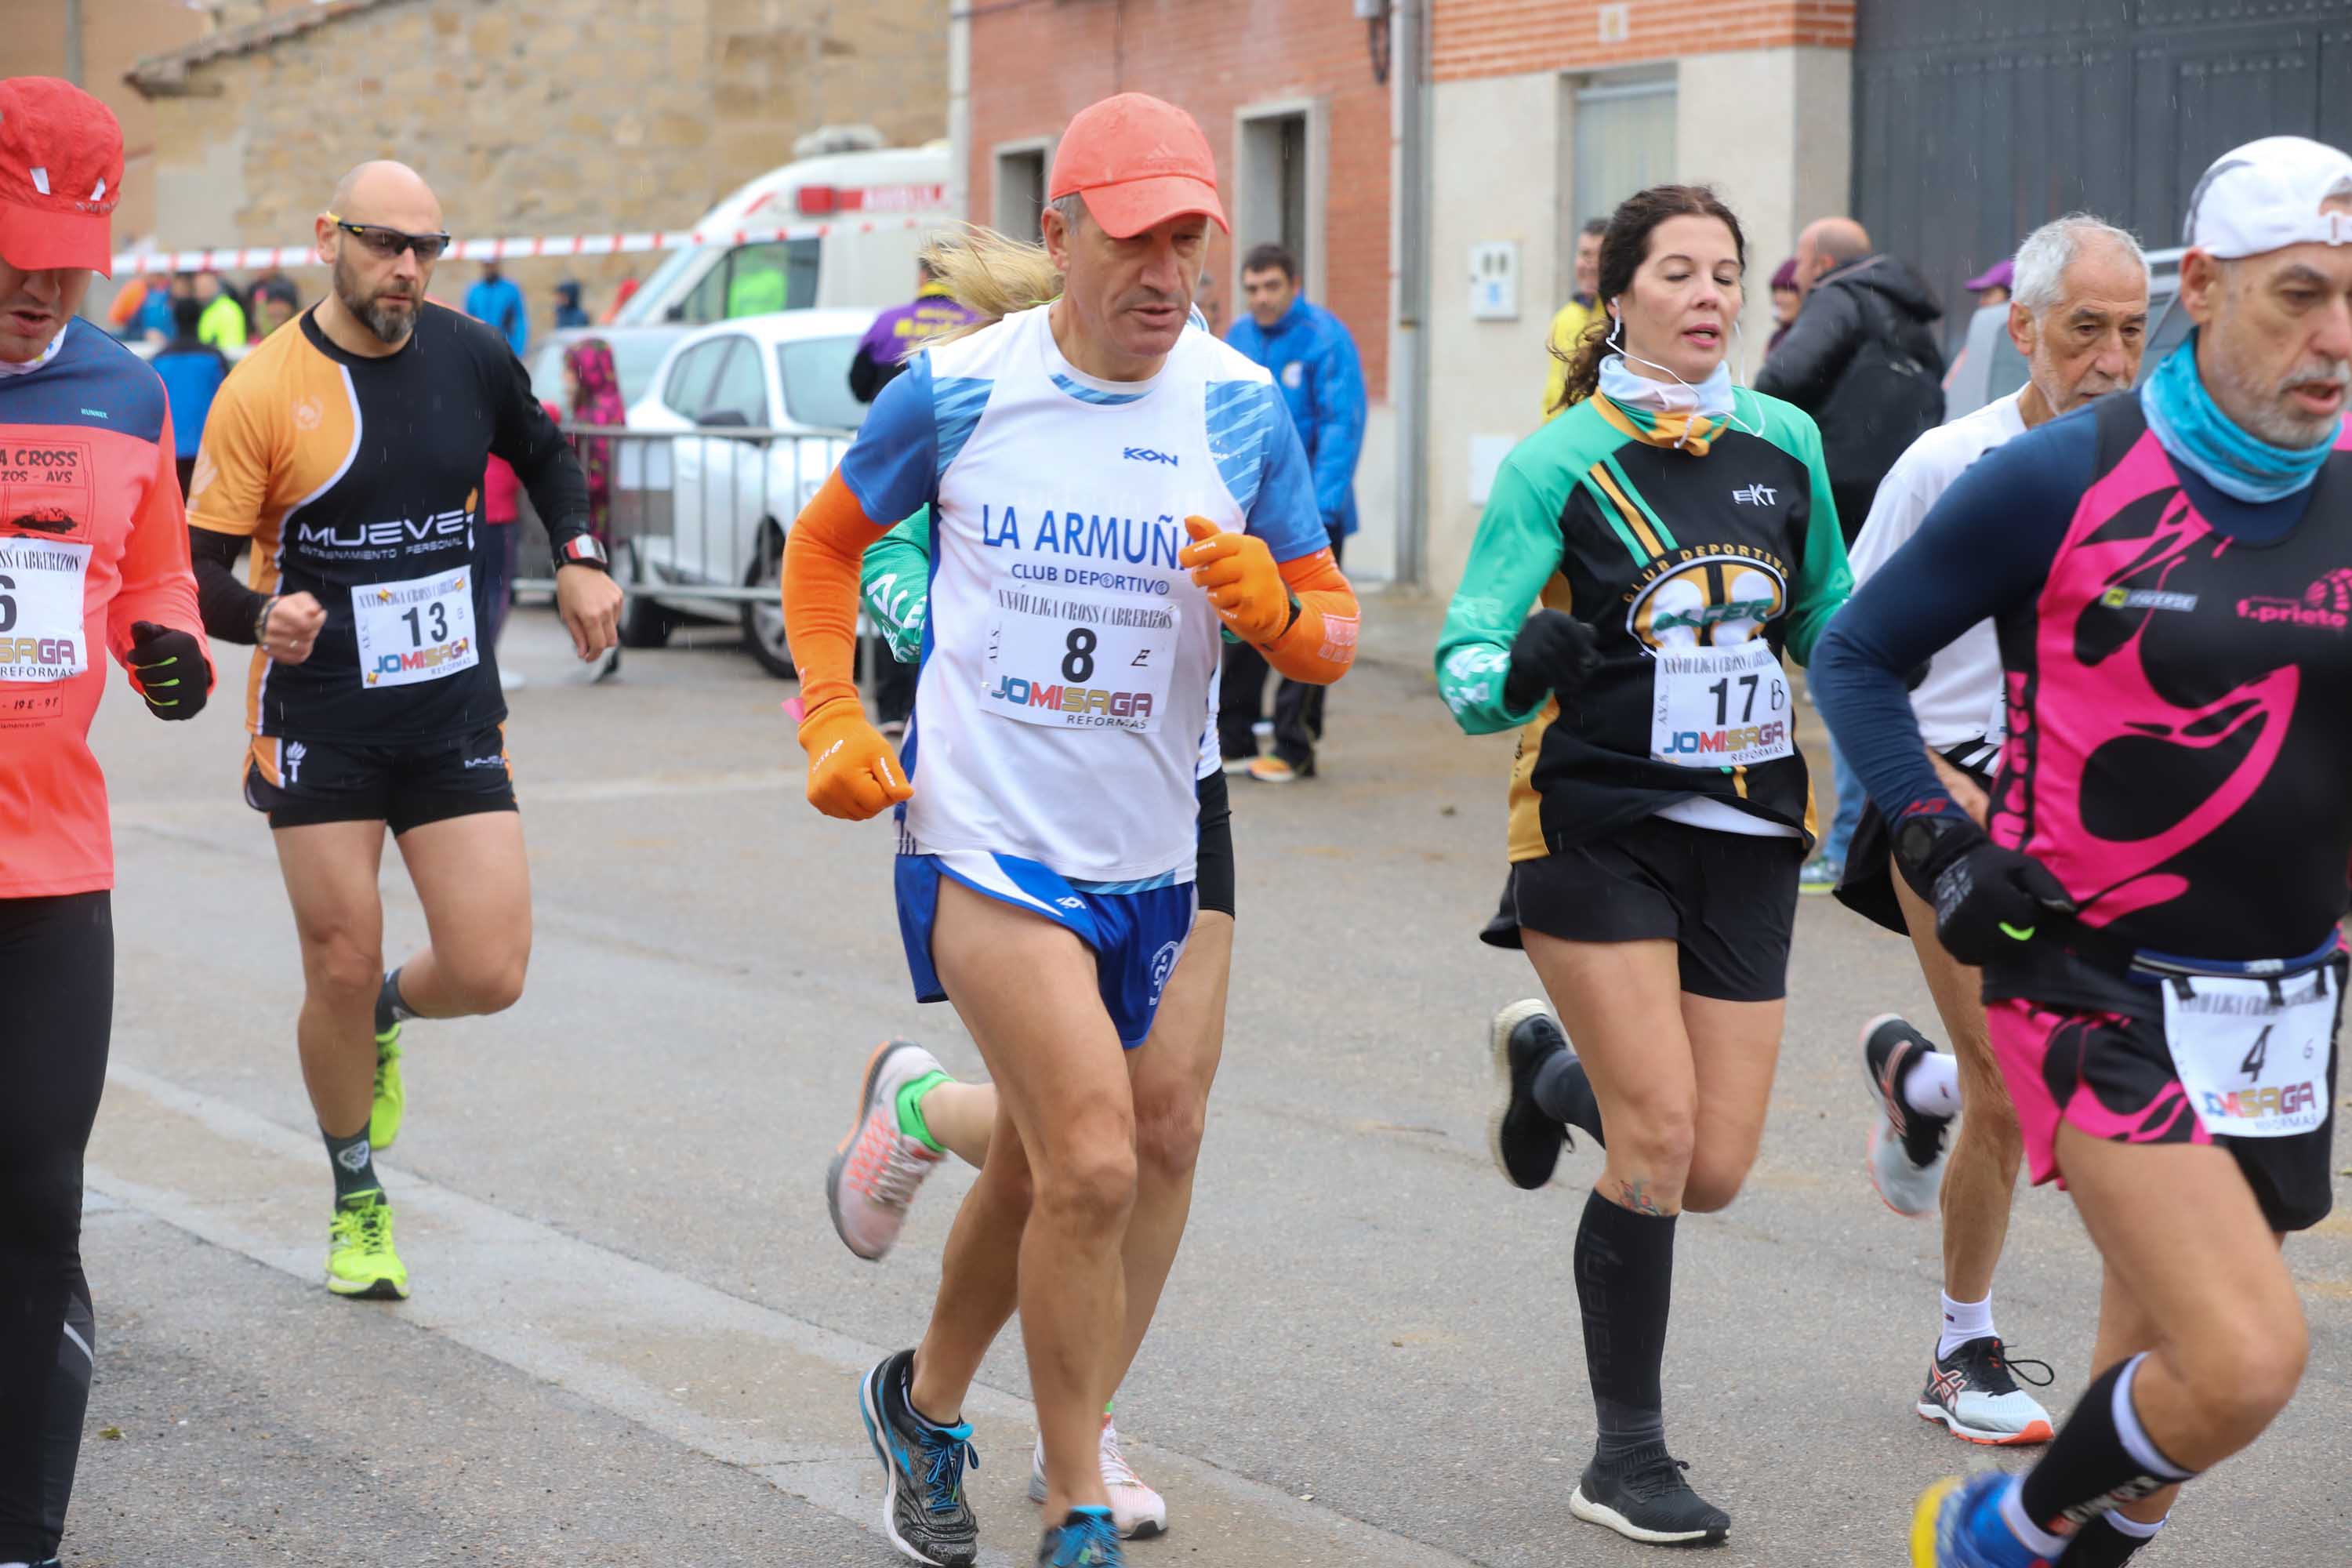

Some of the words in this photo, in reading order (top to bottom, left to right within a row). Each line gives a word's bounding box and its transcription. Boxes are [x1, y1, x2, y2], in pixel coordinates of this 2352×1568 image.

[15, 449, 78, 466] CROSS
[46, 470, 72, 483] AVS
[1732, 483, 1777, 506] EKT
[299, 543, 397, 560] ENTRENAMIENTO
[405, 537, 463, 554] PERSONAL
[983, 504, 1021, 549] LA
[1033, 510, 1192, 571] ARMUÑ
[16, 550, 81, 571] CABRERIZOS
[1011, 564, 1057, 583] CLUB
[1065, 568, 1170, 595] DEPORTIVO
[401, 601, 448, 647] 13
[1032, 595, 1058, 618] LIGA
[1062, 601, 1098, 623] CROSS
[1102, 606, 1173, 628] CABRERIZOS
[1062, 626, 1097, 684] 8
[1131, 649, 1150, 666] E
[0, 666, 75, 678] REFORMAS
[990, 674, 1153, 717] JOMISAGA
[1709, 673, 1759, 726] 17
[1771, 678, 1784, 711] B
[1067, 714, 1148, 730] REFORMAS
[1663, 720, 1784, 754] JOMISAGA
[1730, 742, 1785, 764] REFORMAS
[2240, 1023, 2274, 1083] 4
